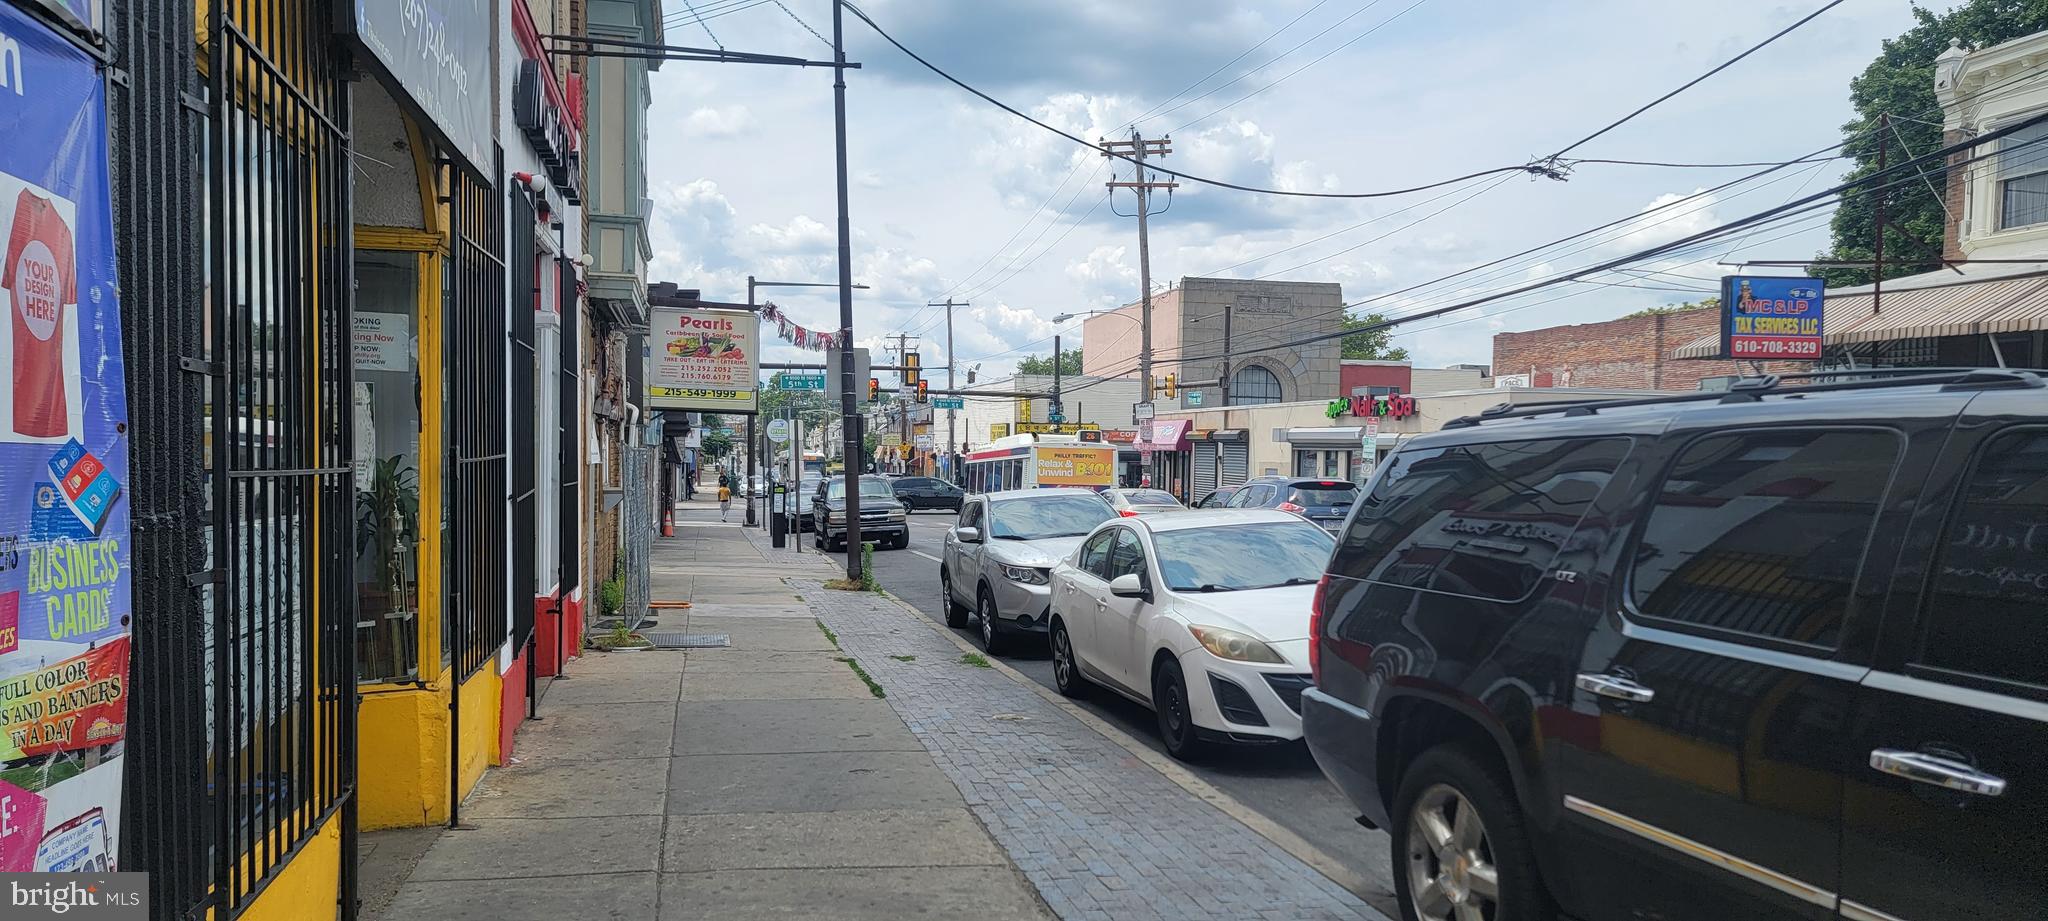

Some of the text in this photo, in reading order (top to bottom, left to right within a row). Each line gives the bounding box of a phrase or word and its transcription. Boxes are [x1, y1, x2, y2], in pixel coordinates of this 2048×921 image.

[24, 258, 54, 283] YOUR
[25, 278, 55, 298] DESIGN
[26, 296, 55, 321] HERE
[1744, 299, 1808, 314] MC & LP
[680, 316, 733, 330] Pearls
[1735, 317, 1818, 335] TAX SERVICES LLC
[374, 334, 394, 342] Now
[1735, 341, 1816, 353] 610-708-3329
[664, 388, 737, 398] 215-549-1999
[1352, 395, 1375, 417] Nails
[1379, 400, 1386, 415] &
[1387, 393, 1412, 420] Spa
[1086, 432, 1096, 440] 26
[1038, 459, 1073, 468] Relax &
[1038, 468, 1073, 477] Unwind
[28, 539, 119, 594] BUSINESS
[47, 587, 110, 640] CARDS
[0, 660, 89, 701] FULL COLOR
[14, 701, 43, 723] AND
[48, 676, 121, 716] BANNERS
[12, 730, 26, 749] IN
[30, 725, 40, 745] A
[44, 719, 74, 742] DAY
[52, 834, 77, 850] COMPANY
